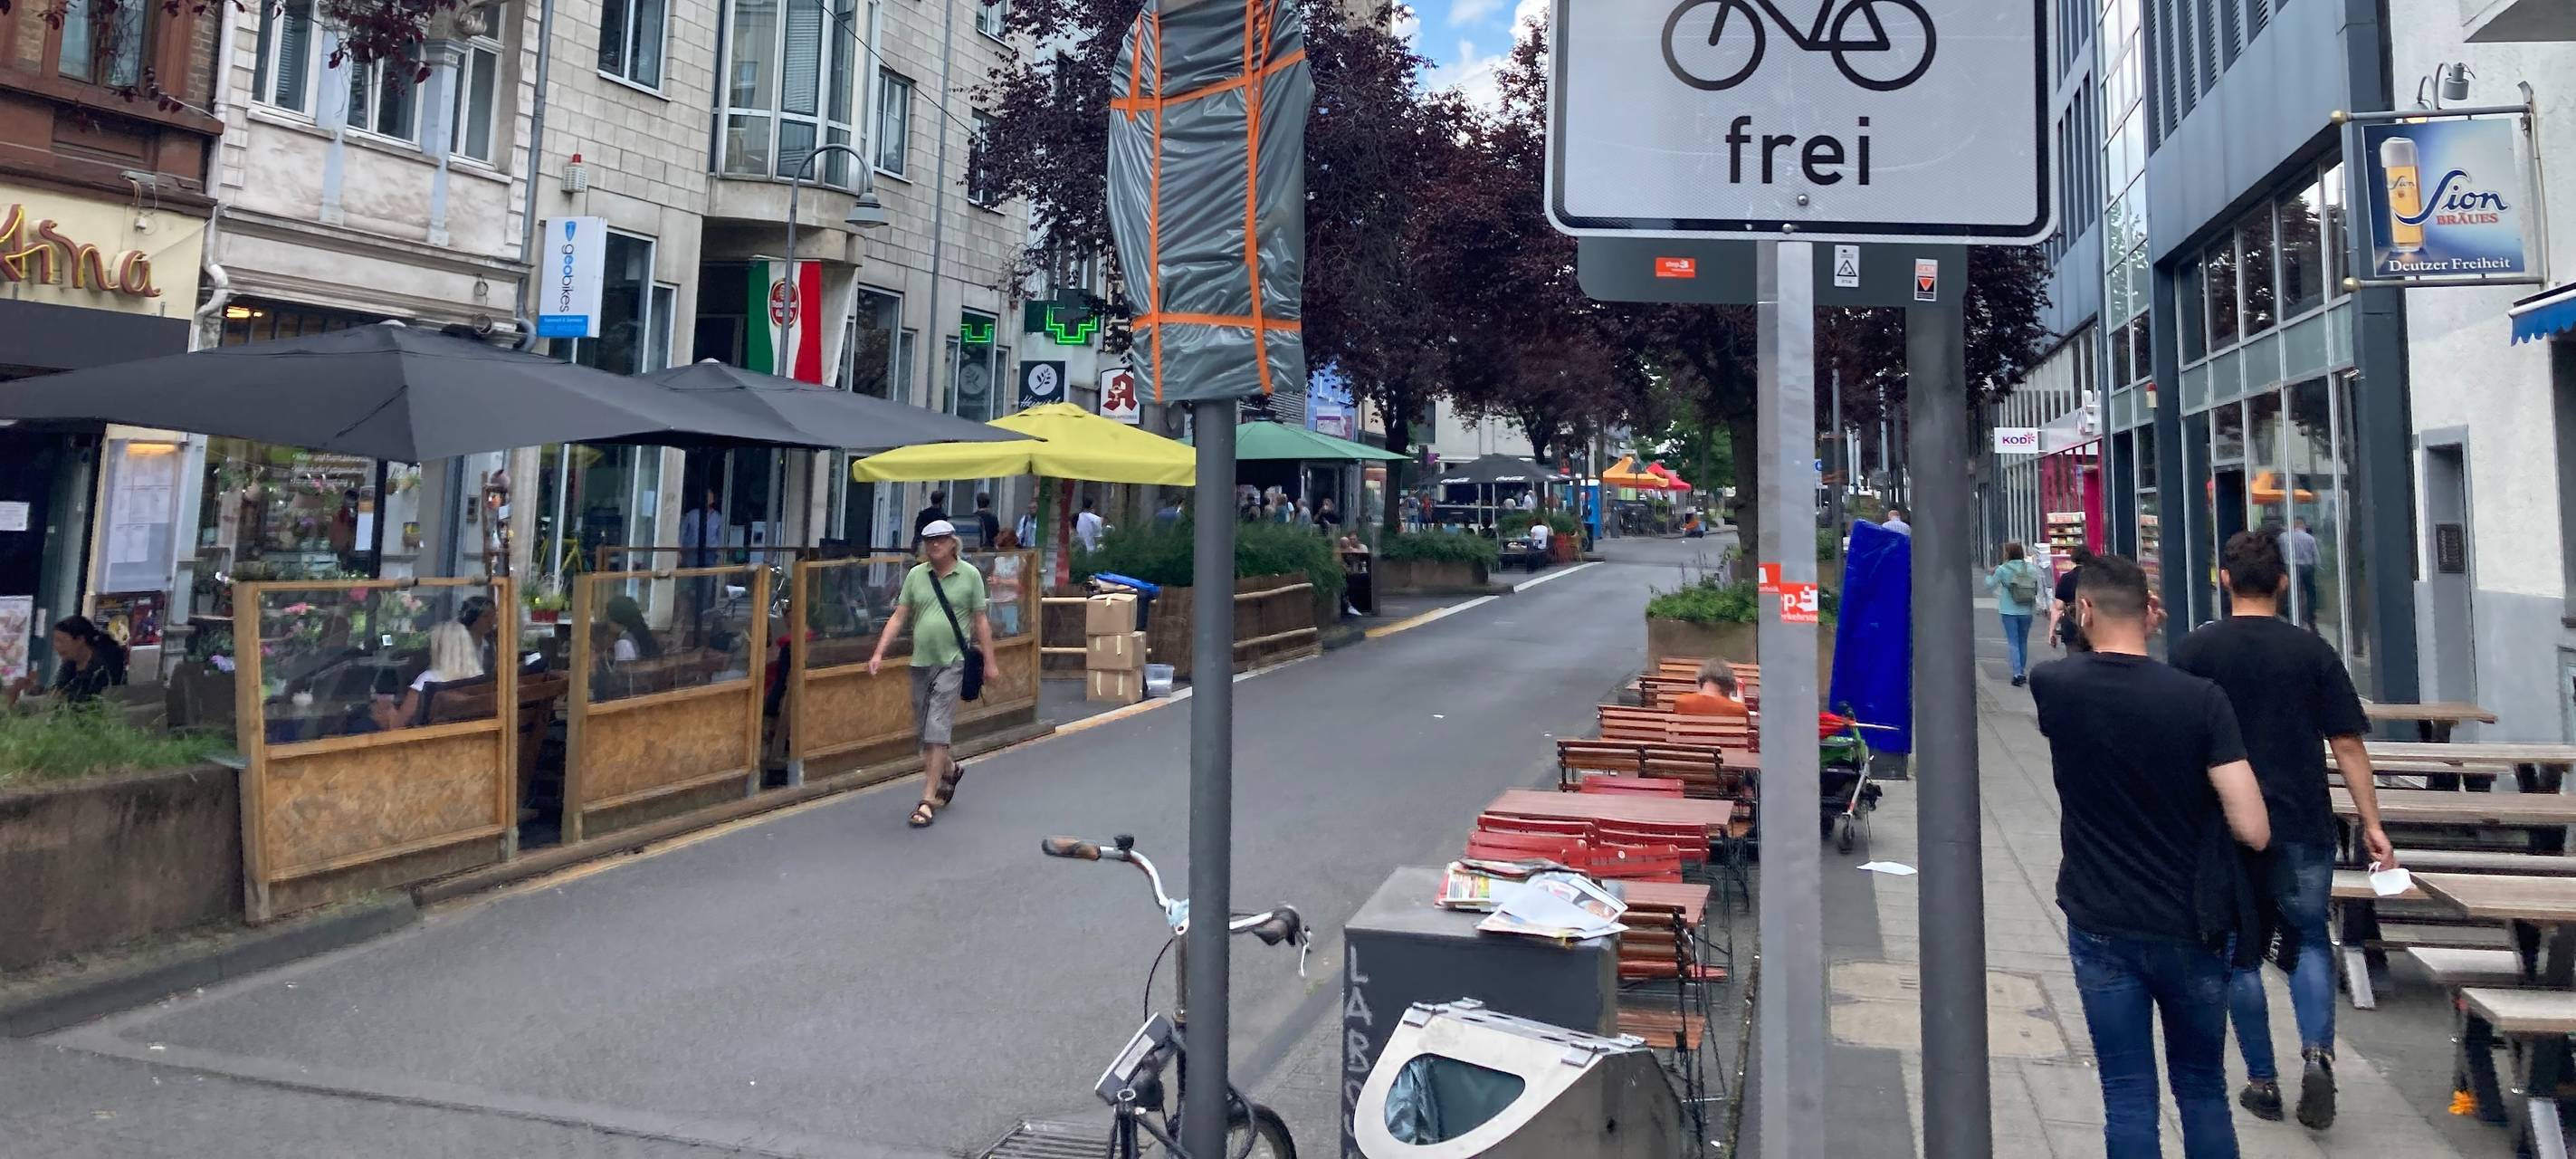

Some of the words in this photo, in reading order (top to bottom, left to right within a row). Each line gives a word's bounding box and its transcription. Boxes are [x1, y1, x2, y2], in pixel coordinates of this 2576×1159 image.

[1725, 115, 1870, 186] frei
[2394, 169, 2509, 225] Sion
[559, 244, 575, 312] geobikes
[2389, 260, 2448, 272] Deutzer
[2451, 257, 2512, 271] Freiheit
